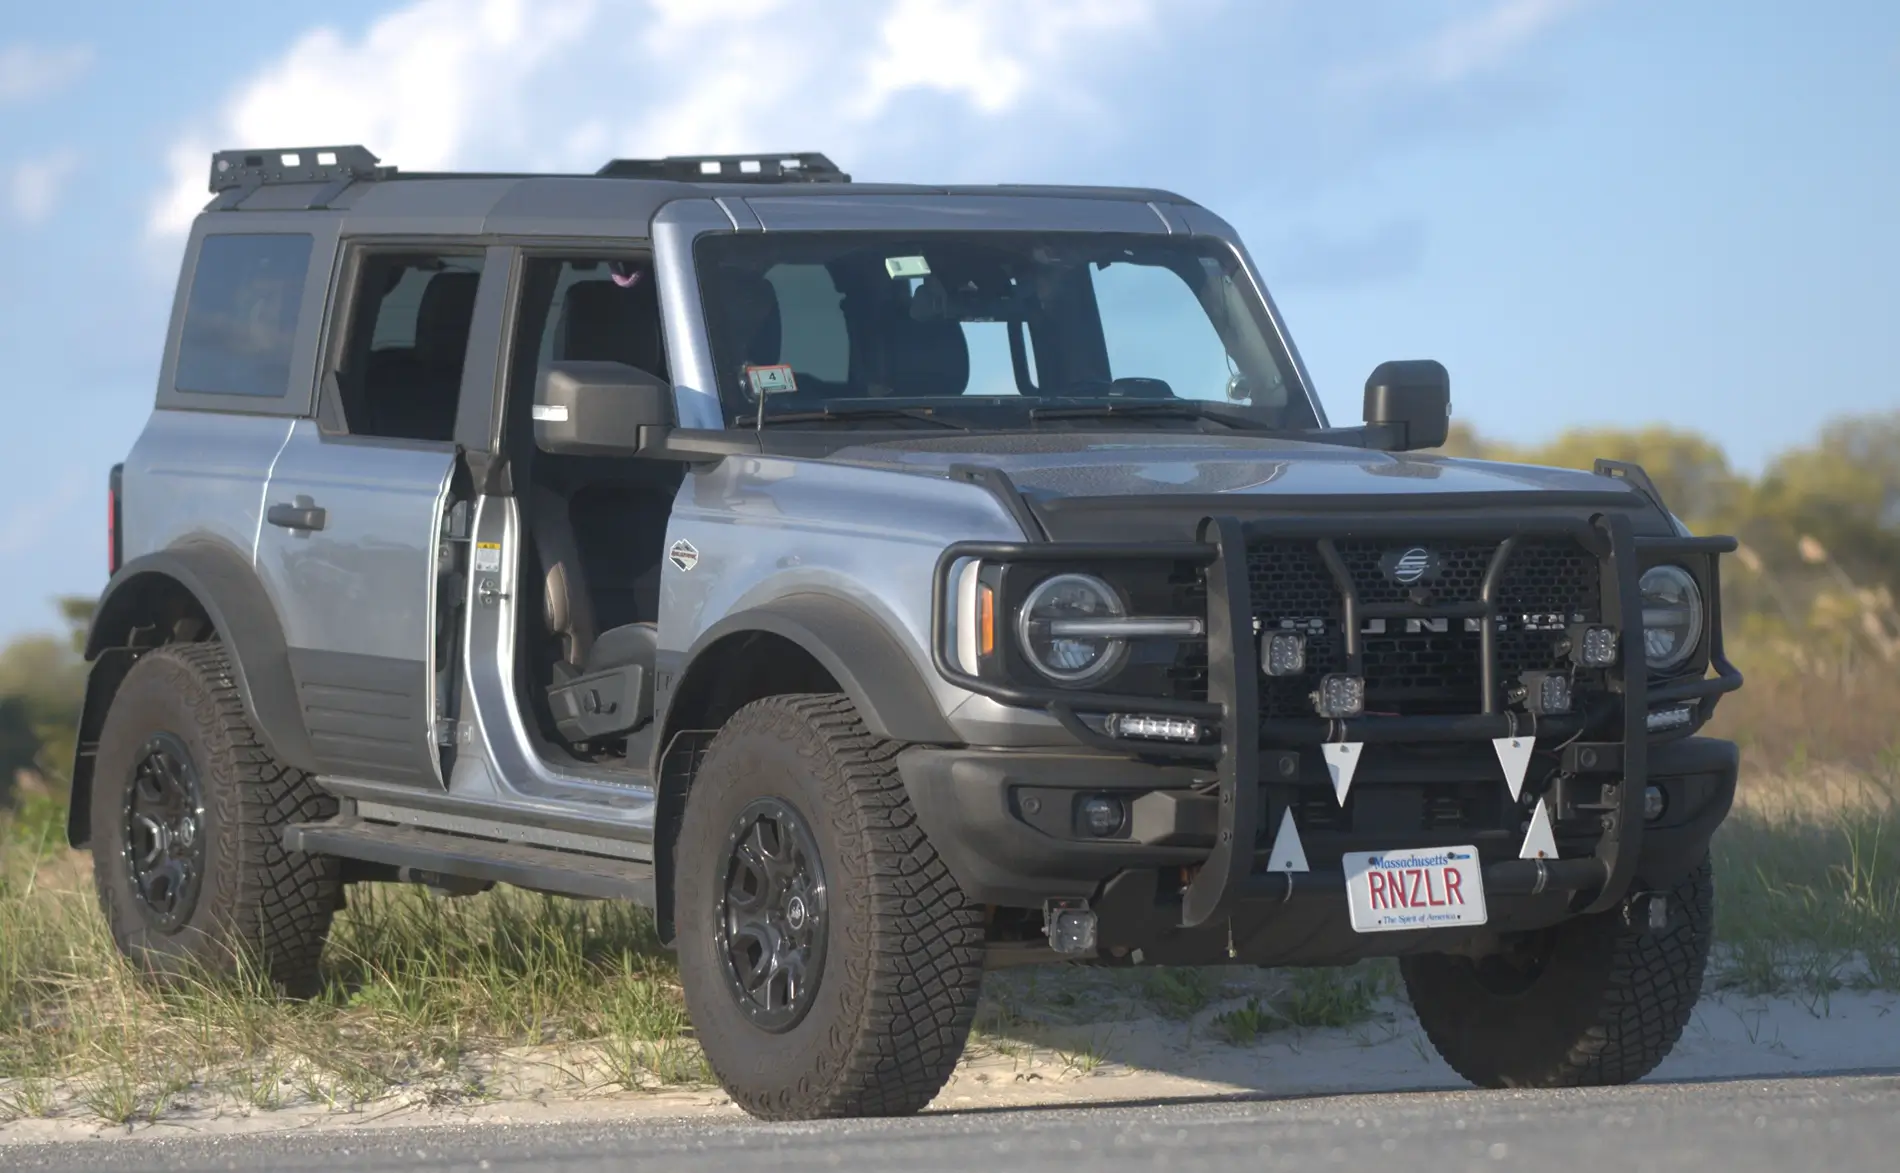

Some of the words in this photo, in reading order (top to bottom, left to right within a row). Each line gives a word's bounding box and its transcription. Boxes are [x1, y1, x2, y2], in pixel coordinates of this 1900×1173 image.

[768, 372, 777, 381] 4
[1373, 854, 1449, 870] Massachusetts
[1367, 867, 1465, 910] RNZLR
[1383, 915, 1396, 925] The
[1398, 914, 1417, 925] Spirit
[1418, 913, 1426, 923] of
[1427, 912, 1457, 922] America
